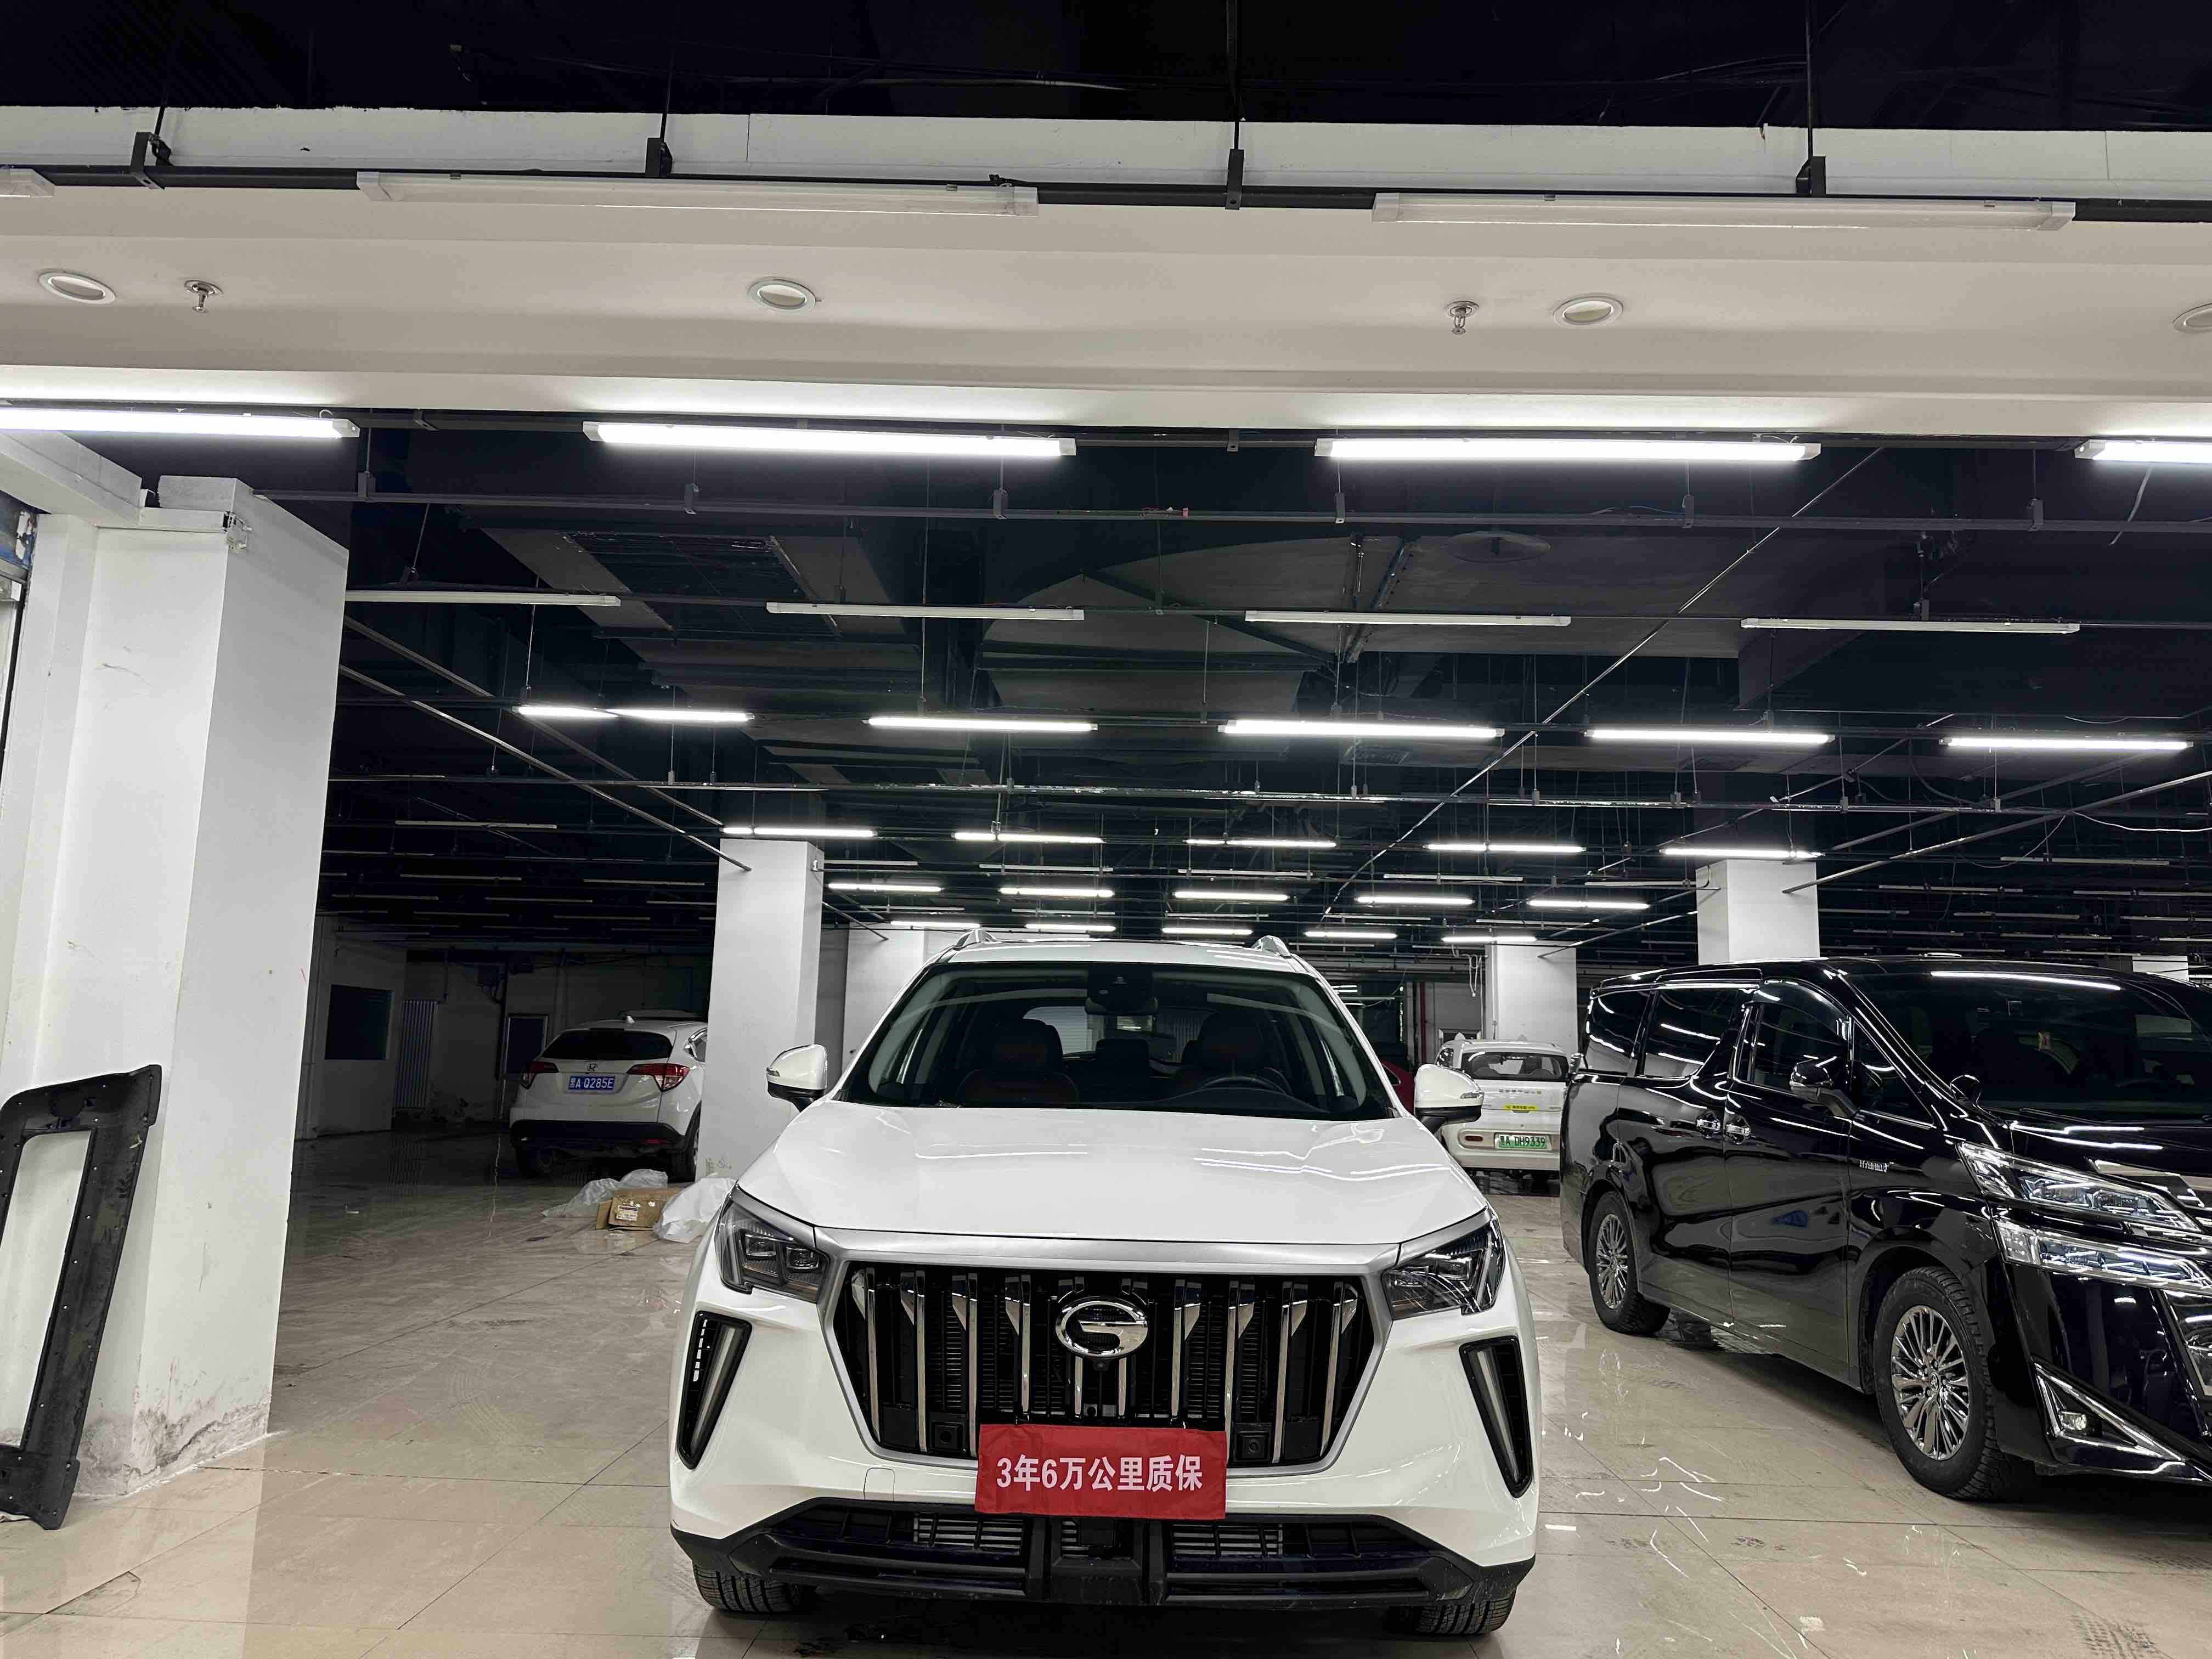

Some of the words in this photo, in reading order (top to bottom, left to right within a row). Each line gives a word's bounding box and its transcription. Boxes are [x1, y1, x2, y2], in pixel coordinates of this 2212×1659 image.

[996, 1454, 1203, 1492] 3年6万公里质保
